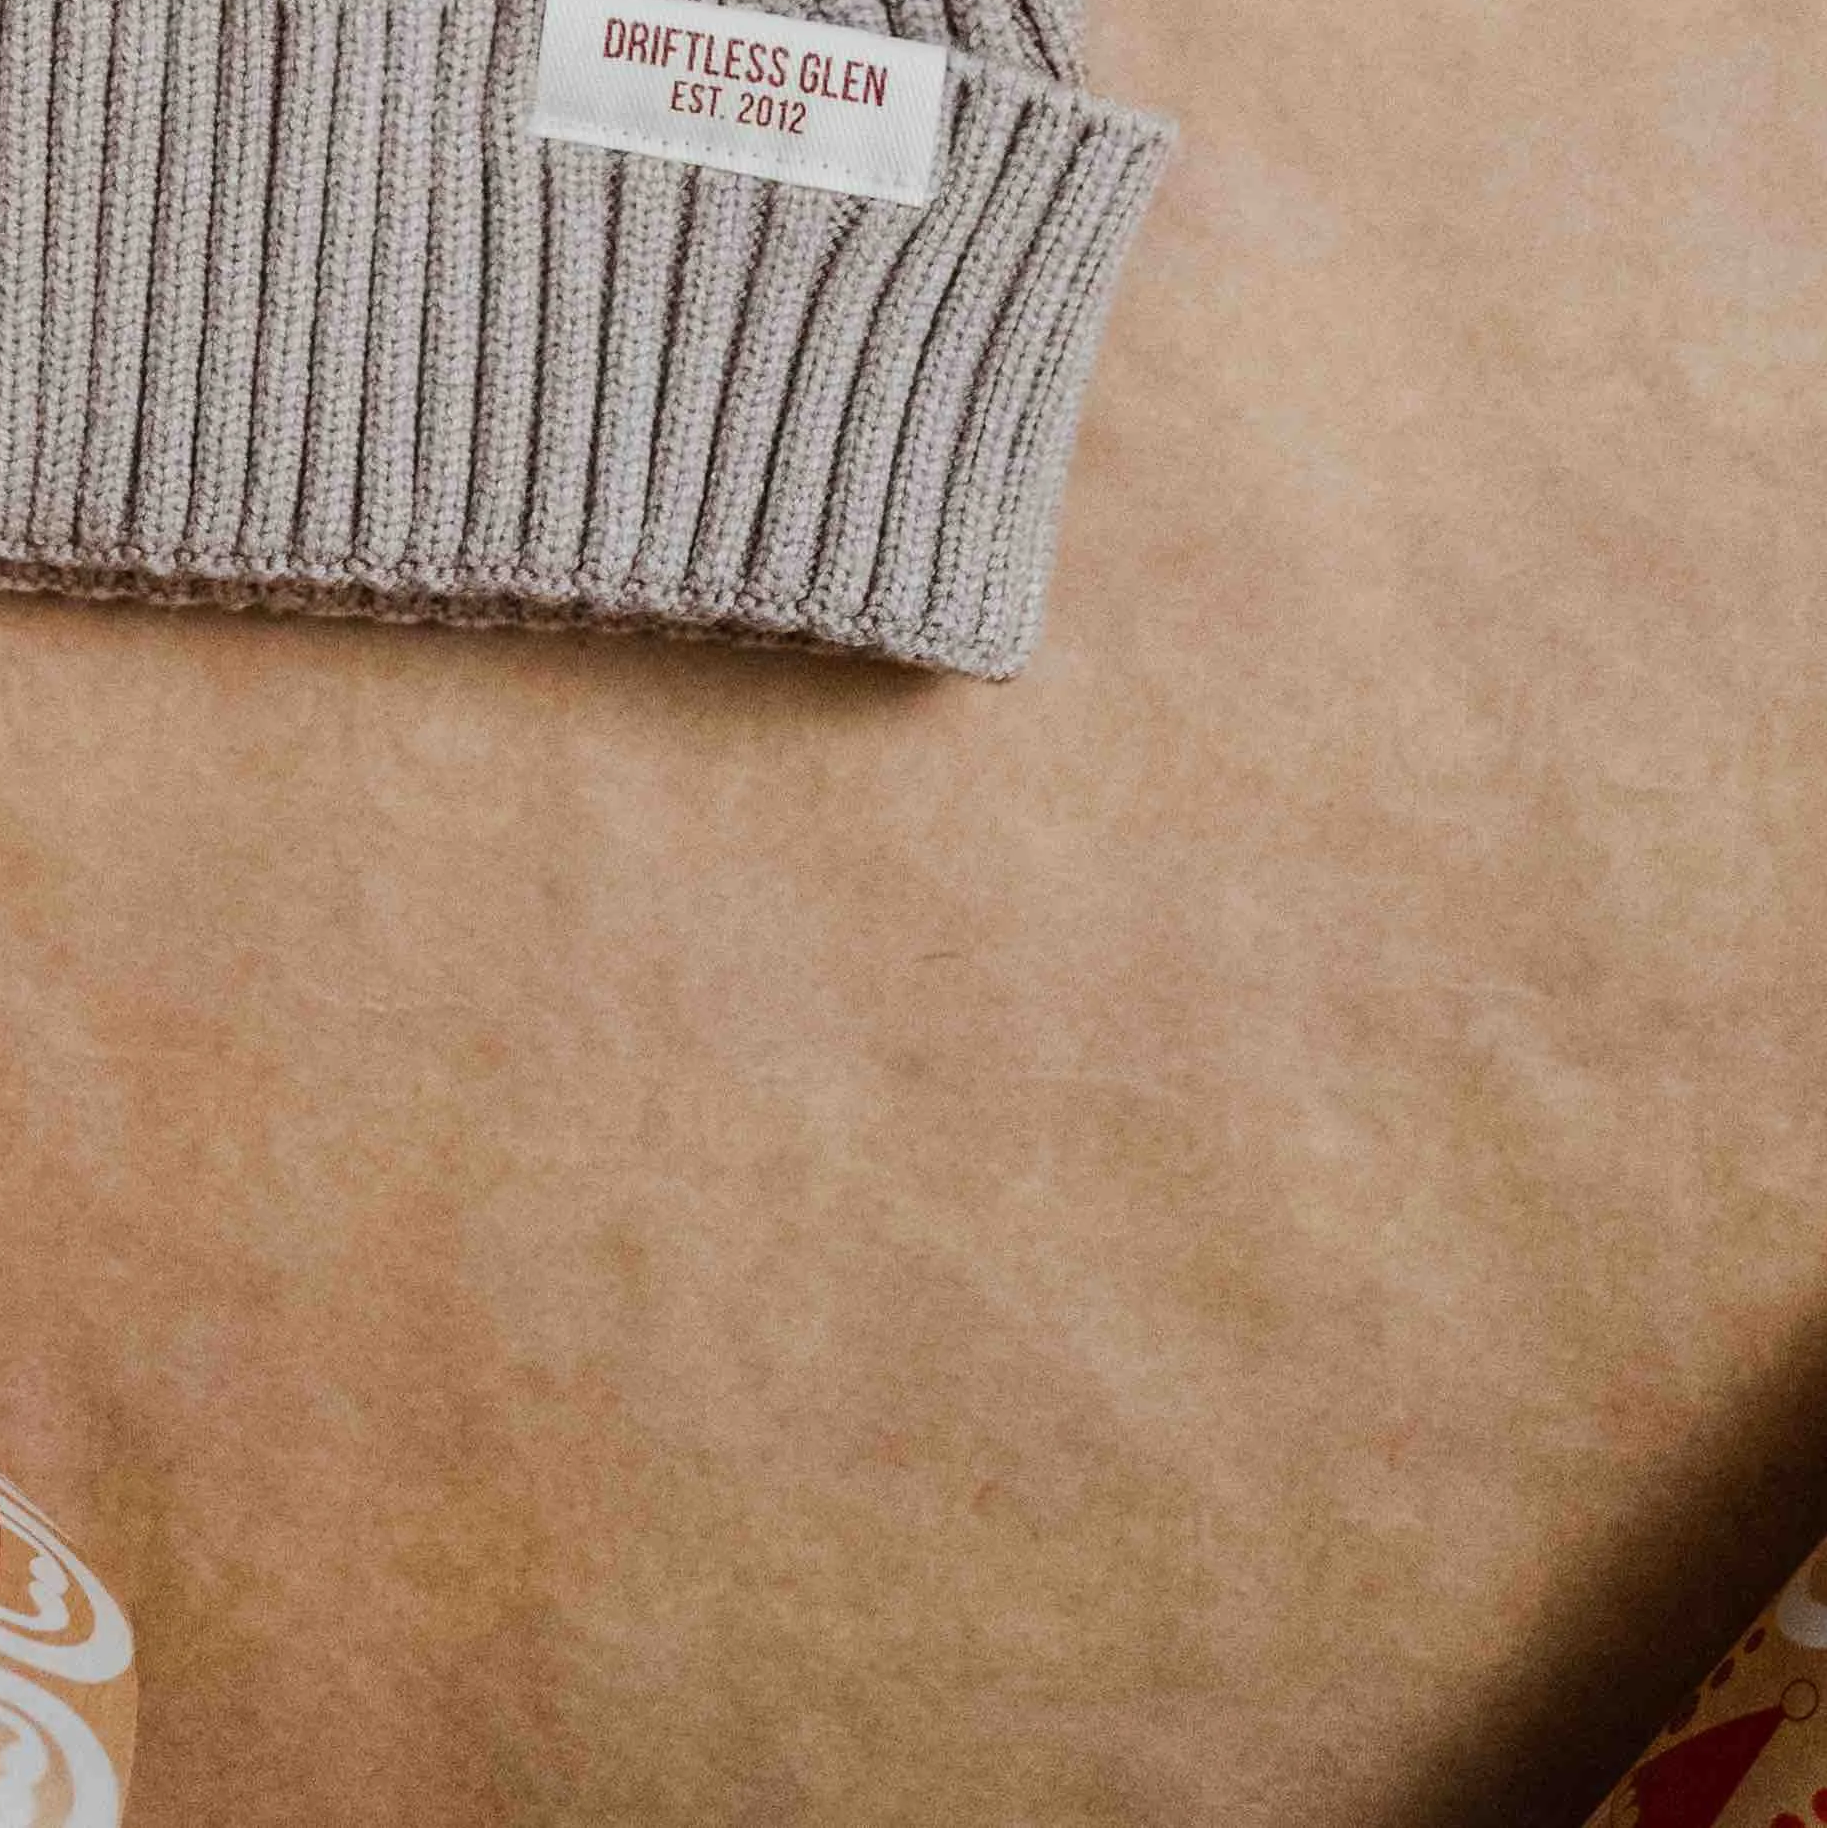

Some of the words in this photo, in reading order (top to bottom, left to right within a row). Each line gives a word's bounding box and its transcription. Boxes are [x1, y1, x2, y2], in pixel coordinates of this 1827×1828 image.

[604, 17, 790, 88] DRIFTLESS
[799, 51, 888, 107] GLEN
[671, 80, 725, 120] EST.
[737, 93, 807, 135] 2012
